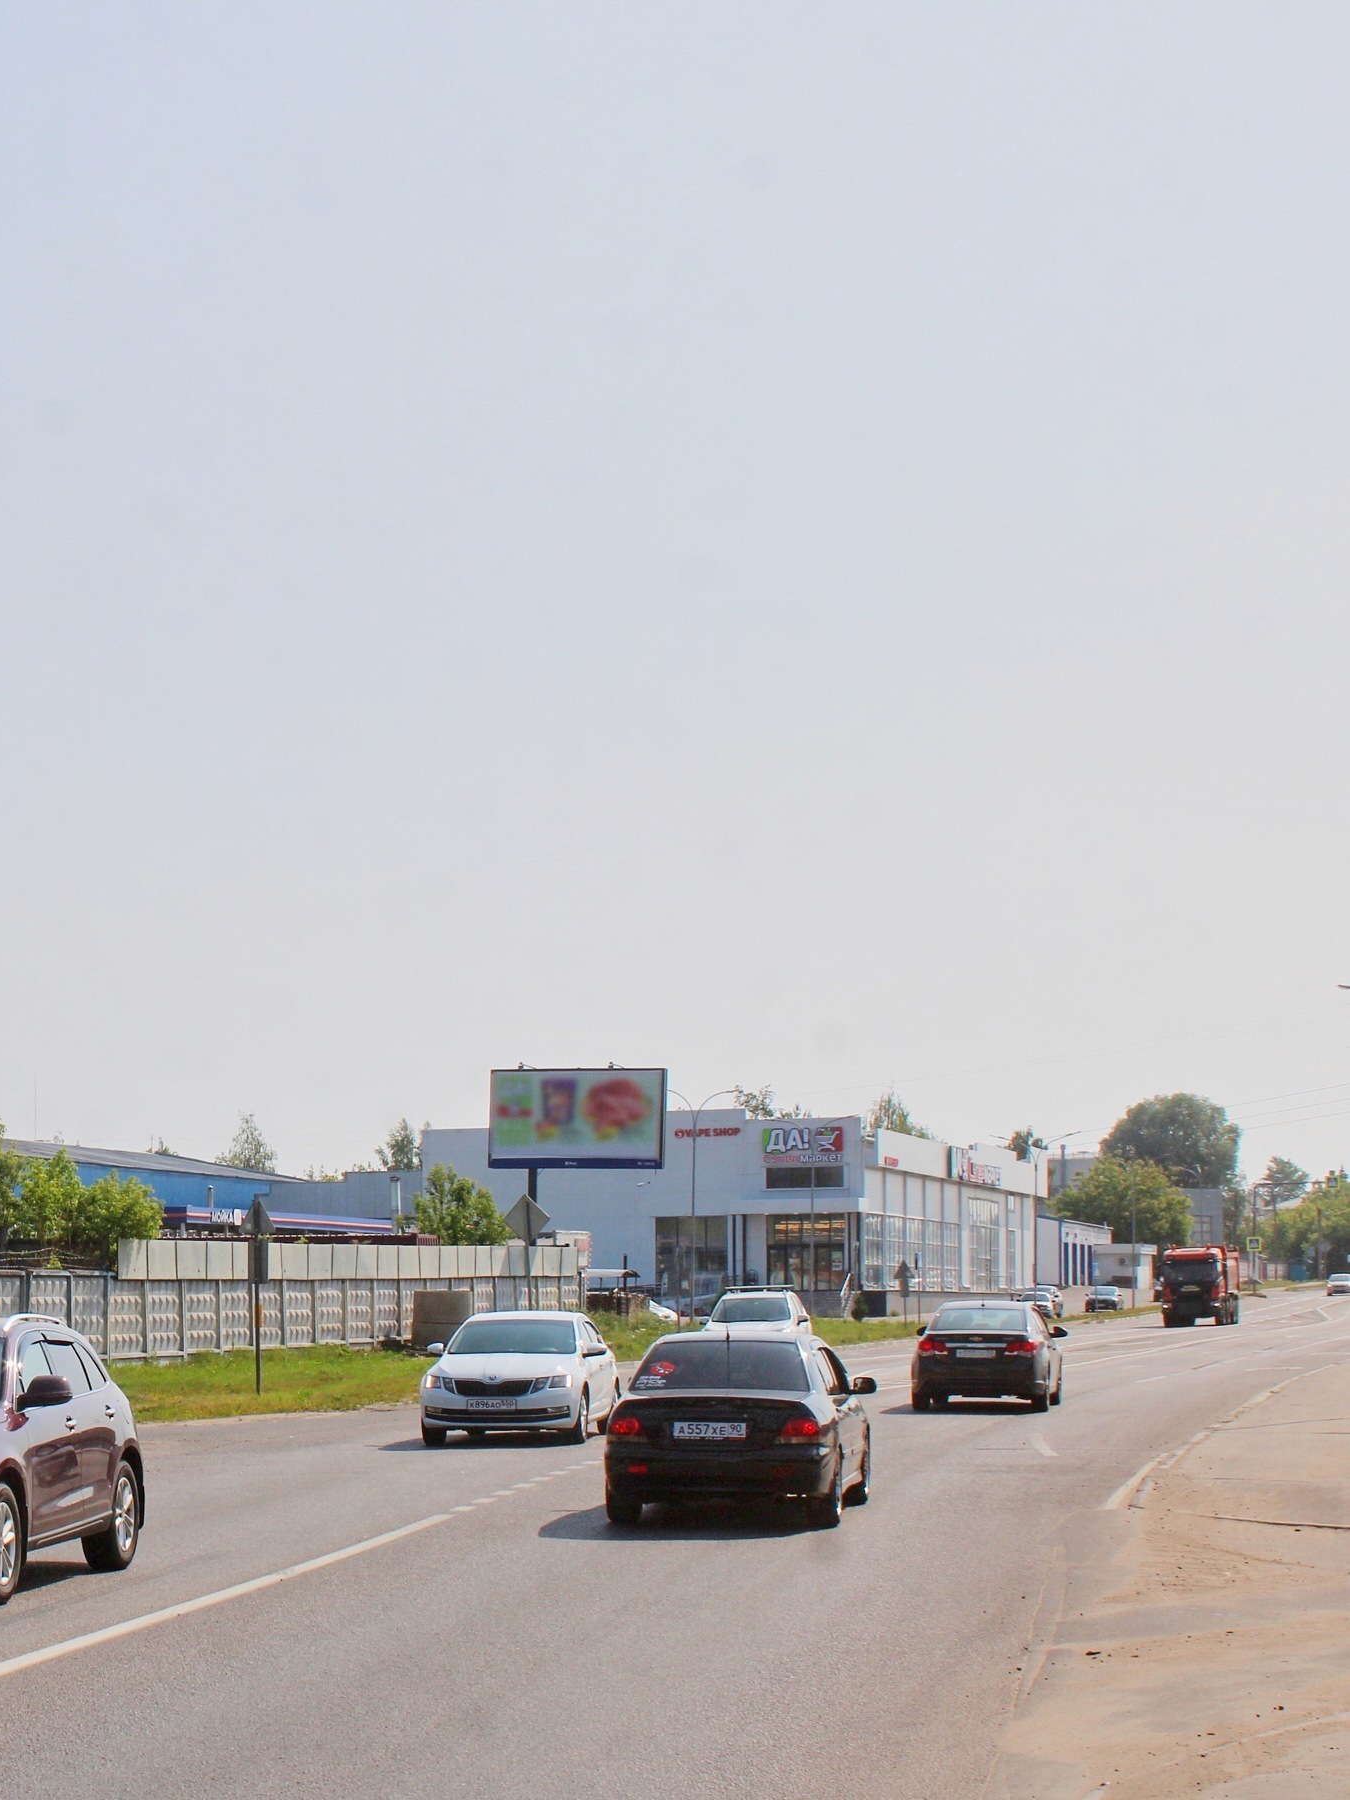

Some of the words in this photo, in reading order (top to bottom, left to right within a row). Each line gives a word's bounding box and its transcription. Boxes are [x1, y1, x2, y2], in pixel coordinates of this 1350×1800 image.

[685, 1128, 711, 1137] VAPE
[712, 1127, 741, 1136] SHOP
[765, 1128, 810, 1153] ДА!
